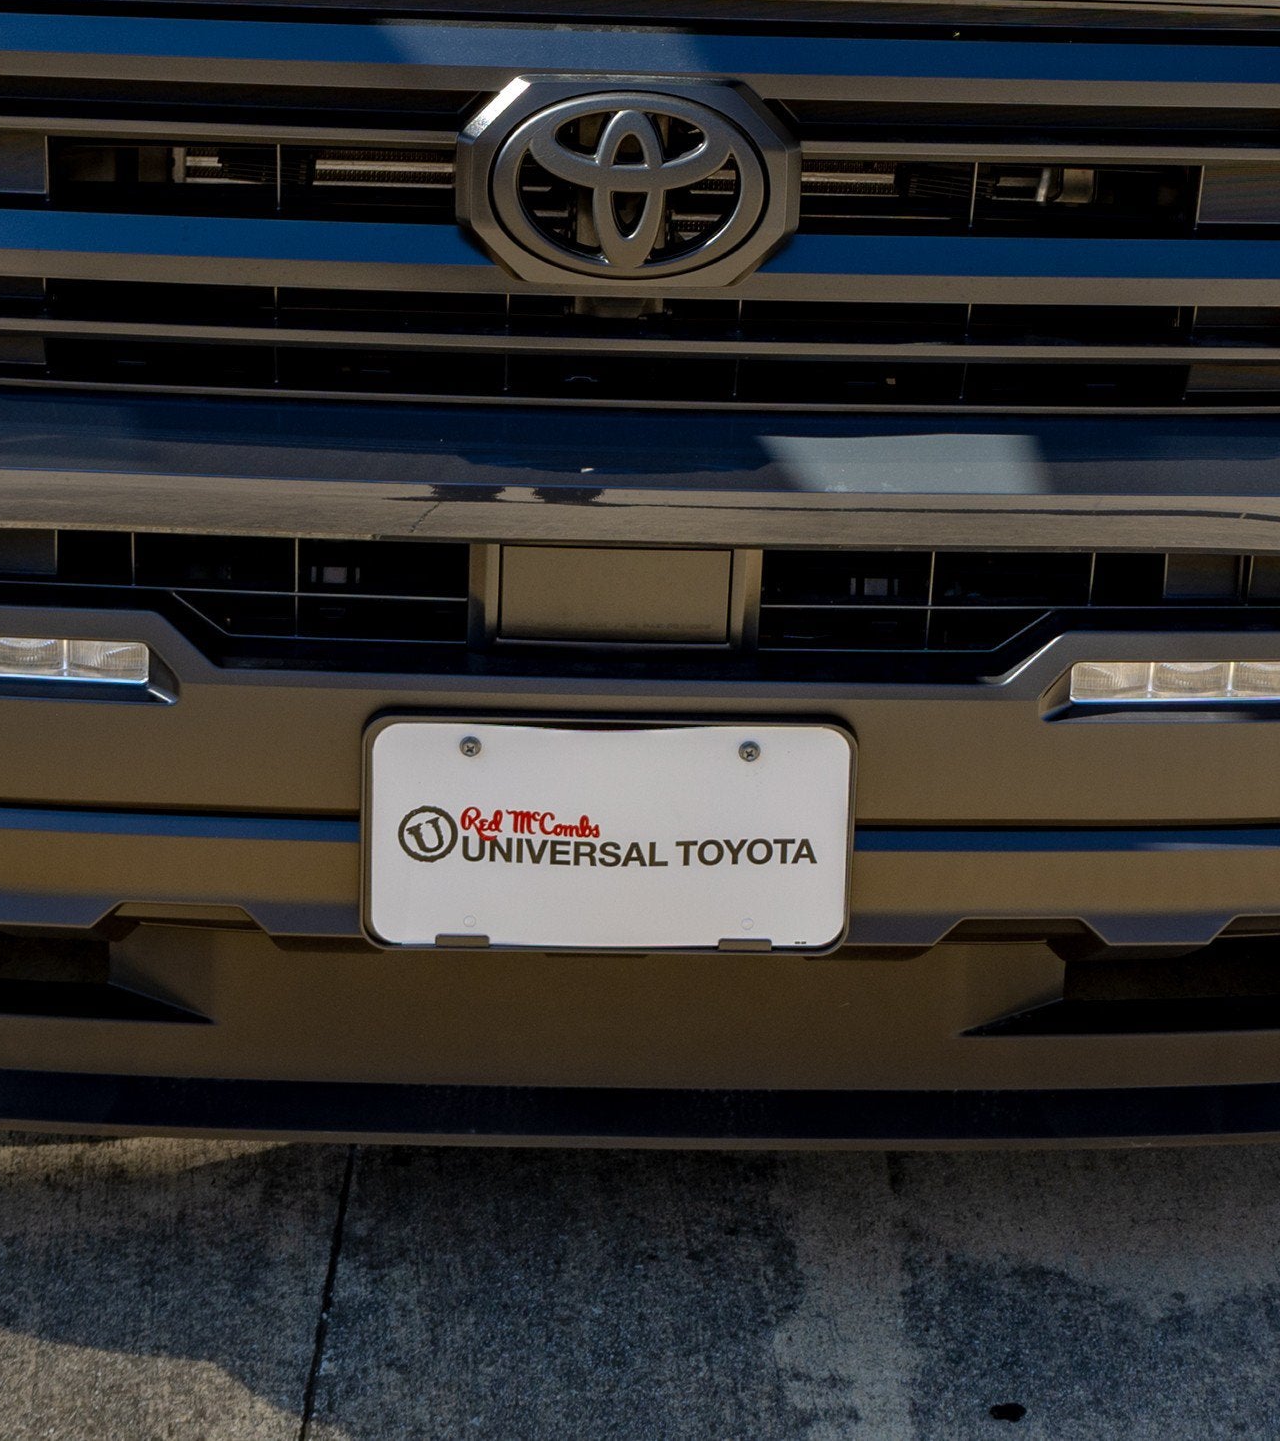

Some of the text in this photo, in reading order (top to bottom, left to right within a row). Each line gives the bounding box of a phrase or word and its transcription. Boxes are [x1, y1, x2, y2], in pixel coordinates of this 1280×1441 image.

[460, 806, 600, 841] Red McCombs
[461, 835, 818, 867] UNIVERSAL TOYOTA
